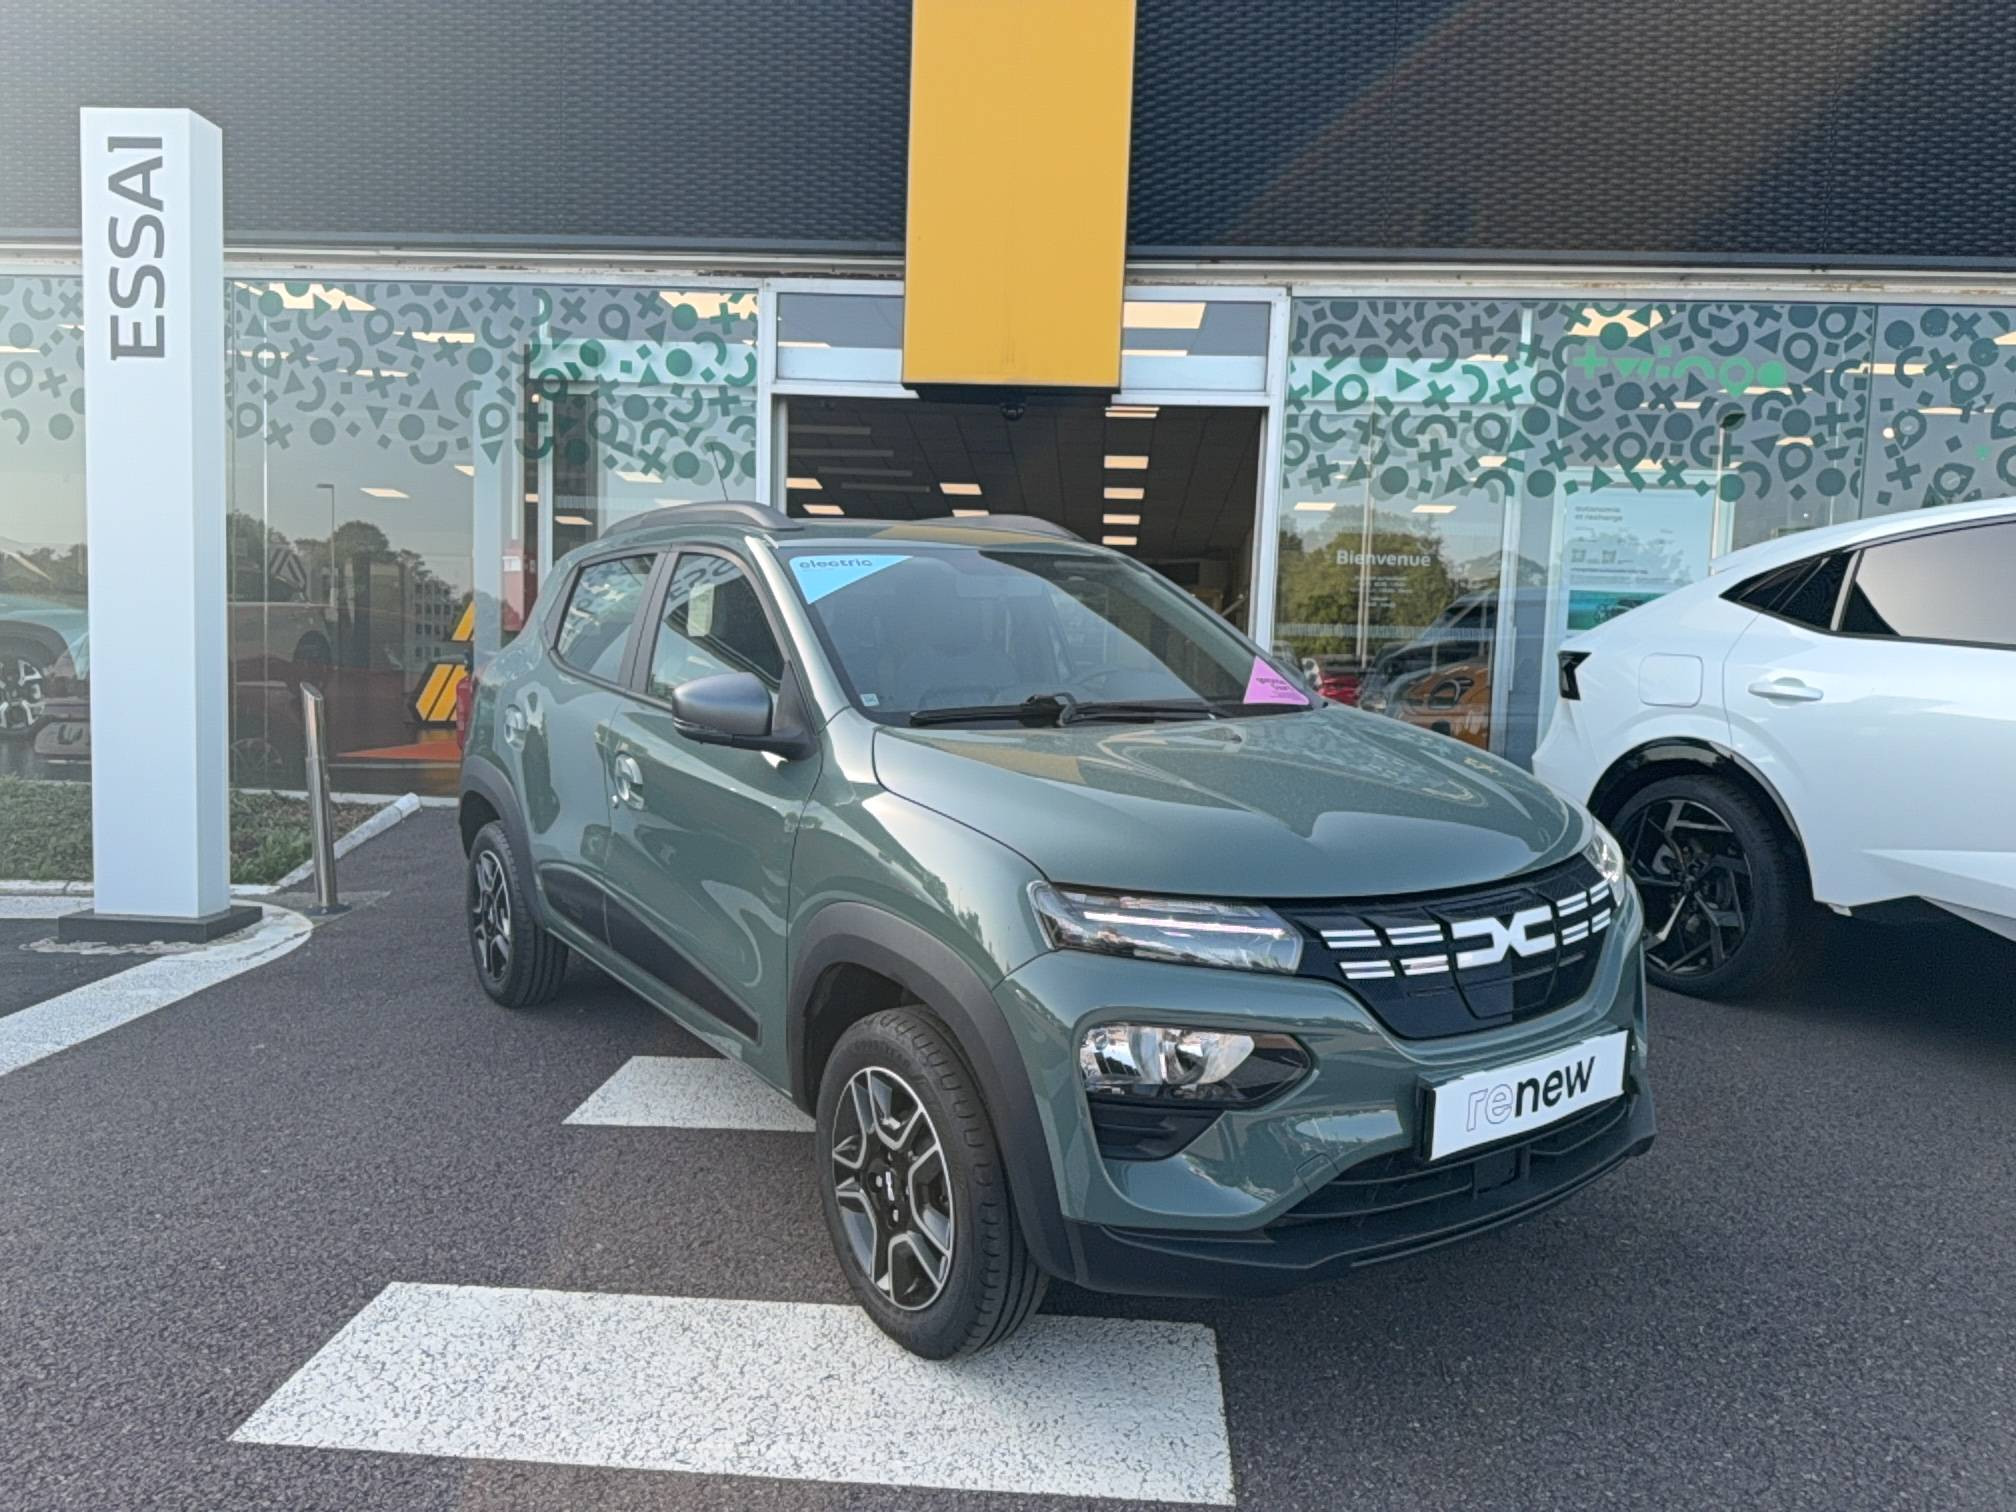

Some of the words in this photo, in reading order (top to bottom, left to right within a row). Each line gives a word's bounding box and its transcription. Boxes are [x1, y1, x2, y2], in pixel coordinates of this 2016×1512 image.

[108, 136, 166, 361] ESSAI
[799, 558, 873, 569] electric
[1336, 549, 1432, 567] Bienvenue
[1465, 1056, 1596, 1133] renew
